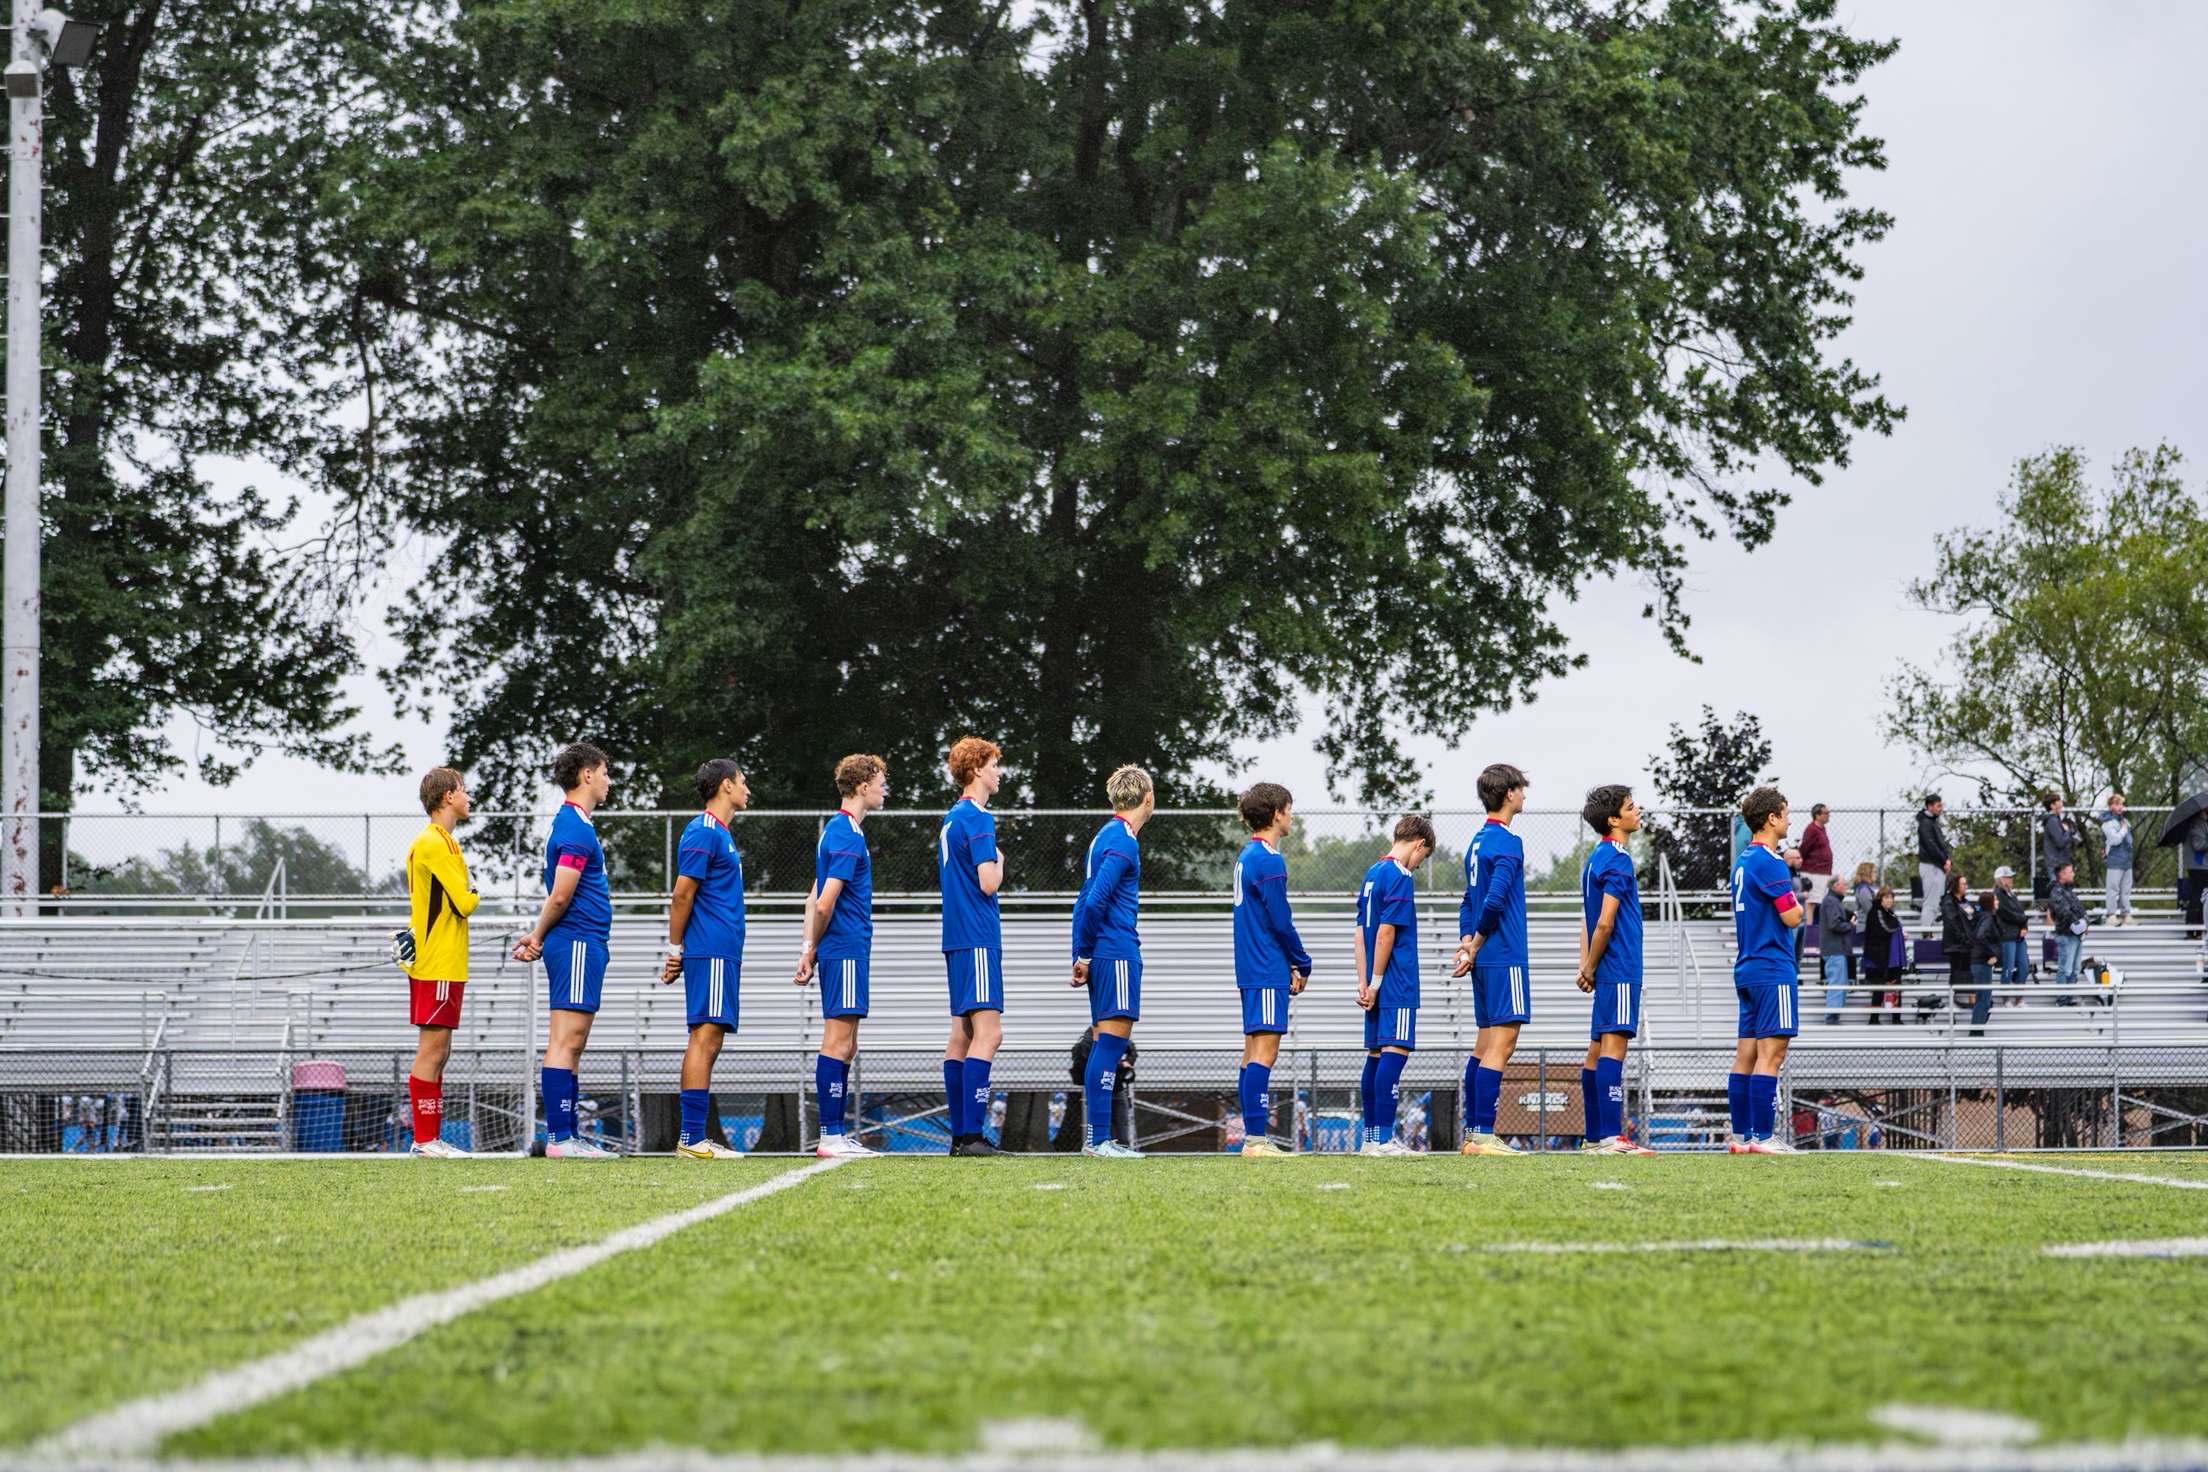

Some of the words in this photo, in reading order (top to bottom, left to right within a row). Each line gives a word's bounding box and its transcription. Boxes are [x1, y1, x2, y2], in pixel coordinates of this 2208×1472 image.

[572, 855, 585, 869] C
[1233, 861, 1243, 907] 0
[1470, 841, 1480, 887] 5
[1363, 881, 1374, 927] 7
[1735, 866, 1745, 911] 2
